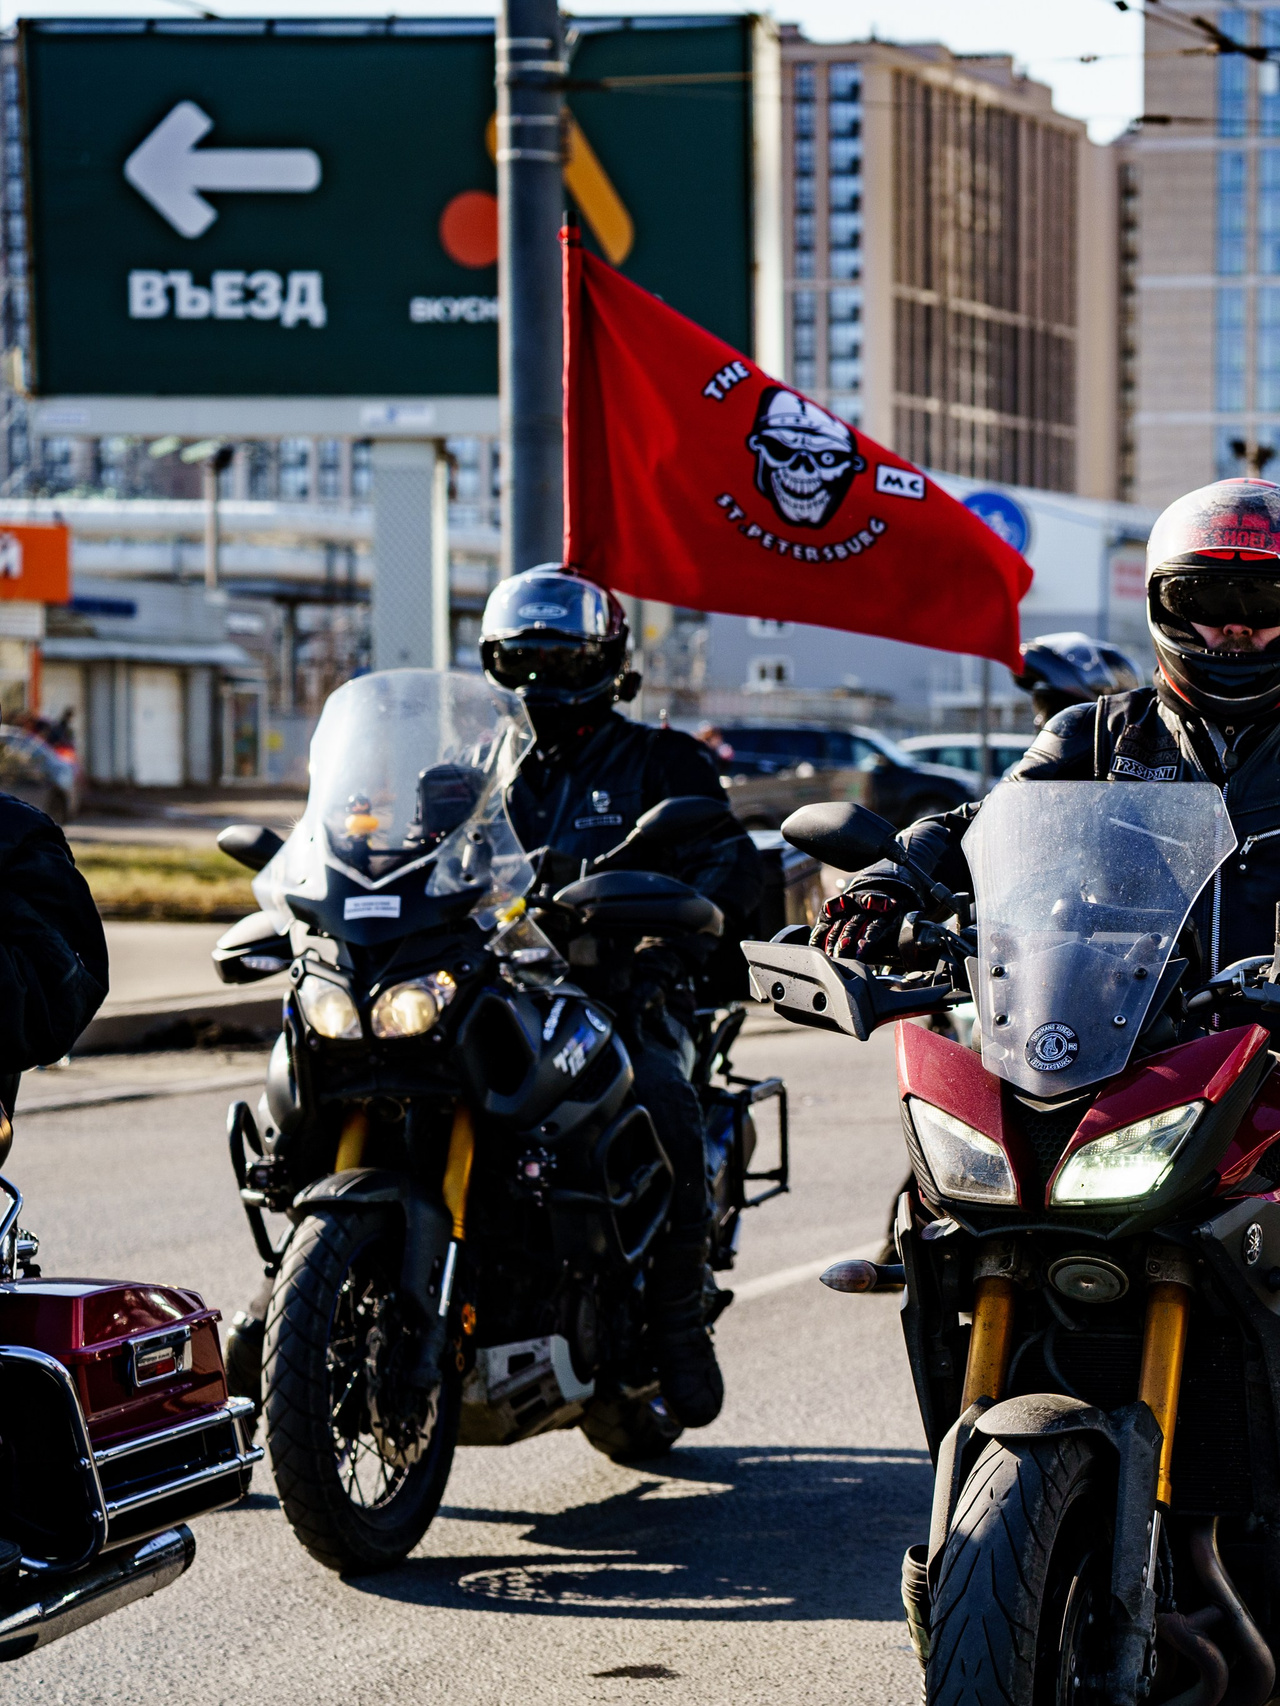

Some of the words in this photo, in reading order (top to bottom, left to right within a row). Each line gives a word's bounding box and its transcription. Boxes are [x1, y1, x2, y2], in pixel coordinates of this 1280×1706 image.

[128, 269, 327, 328] ВЪЕЗД
[410, 297, 499, 323] ВКУСН
[703, 361, 751, 400] THE
[883, 474, 920, 493] MC
[1212, 530, 1266, 548] SHOEI
[1115, 759, 1174, 779] PRESIDENT
